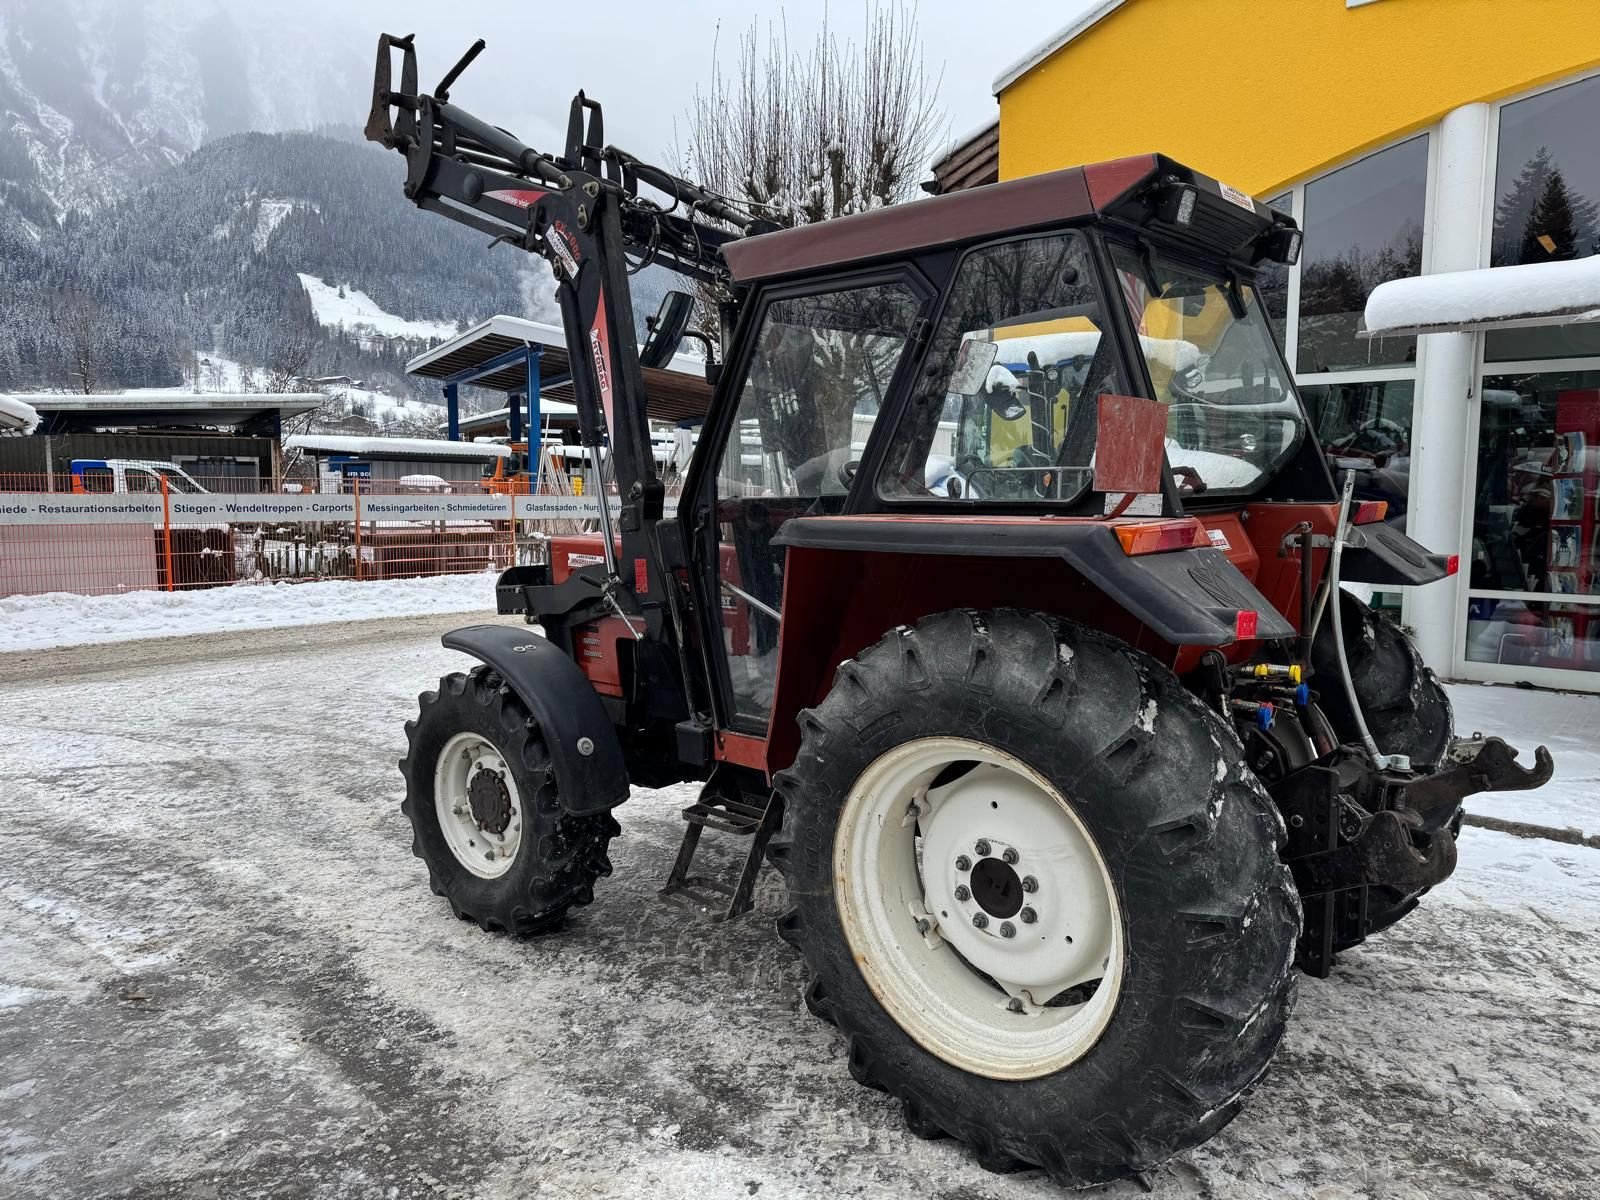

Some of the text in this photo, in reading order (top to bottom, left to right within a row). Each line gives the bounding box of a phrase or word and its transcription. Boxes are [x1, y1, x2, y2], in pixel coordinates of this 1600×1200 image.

[592, 340, 607, 391] HYDRAC
[0, 504, 28, 514] iede
[38, 503, 162, 514] Restaurationsarbeiten
[173, 503, 216, 515] Stiegen
[225, 503, 303, 515] Wendeltreppen
[311, 503, 354, 514] Carports
[367, 503, 440, 514] Messingarbeiten
[447, 502, 507, 512] Schmiedetüren
[525, 503, 577, 512] Glasfassaden
